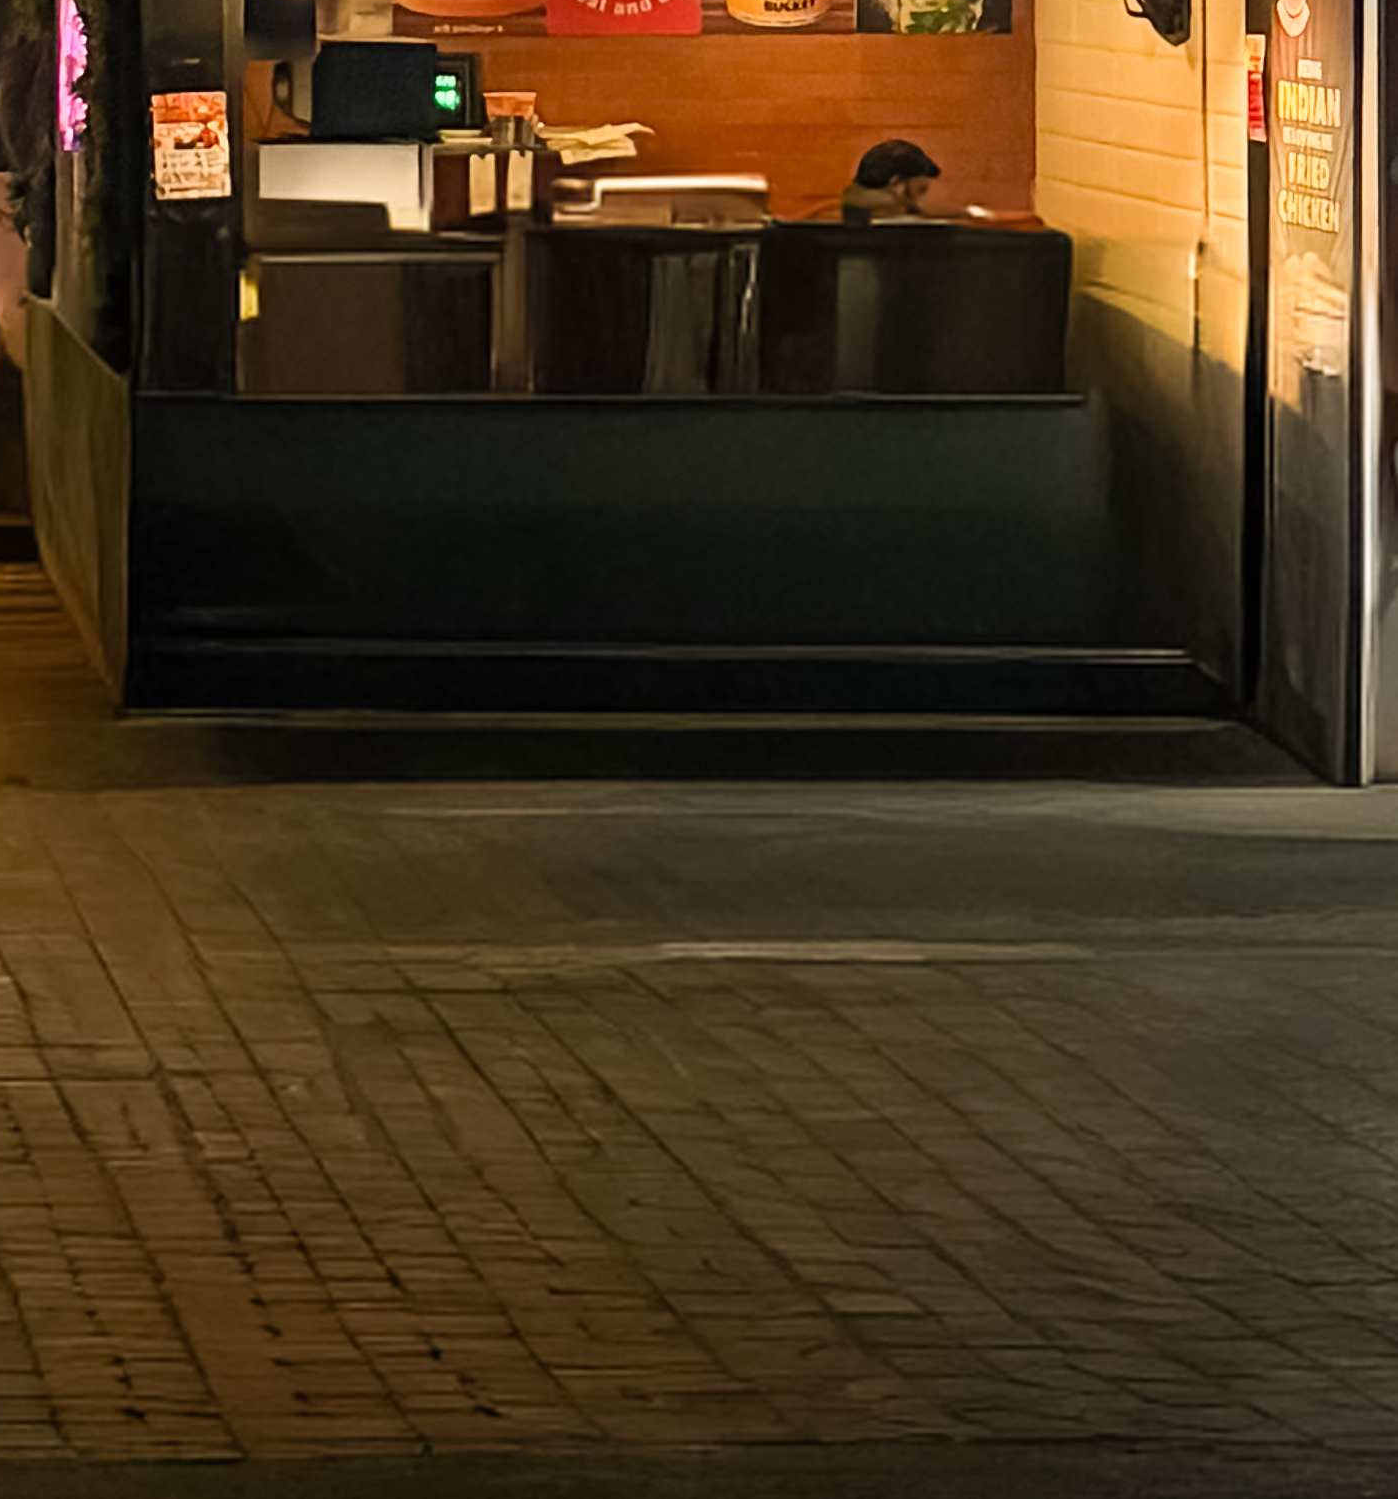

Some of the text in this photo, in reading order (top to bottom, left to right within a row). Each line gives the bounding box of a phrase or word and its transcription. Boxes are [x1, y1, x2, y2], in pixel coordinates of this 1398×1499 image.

[1278, 80, 1340, 127] INDIAN
[1289, 153, 1330, 190] FRIED
[1279, 190, 1340, 233] CHICKEN
